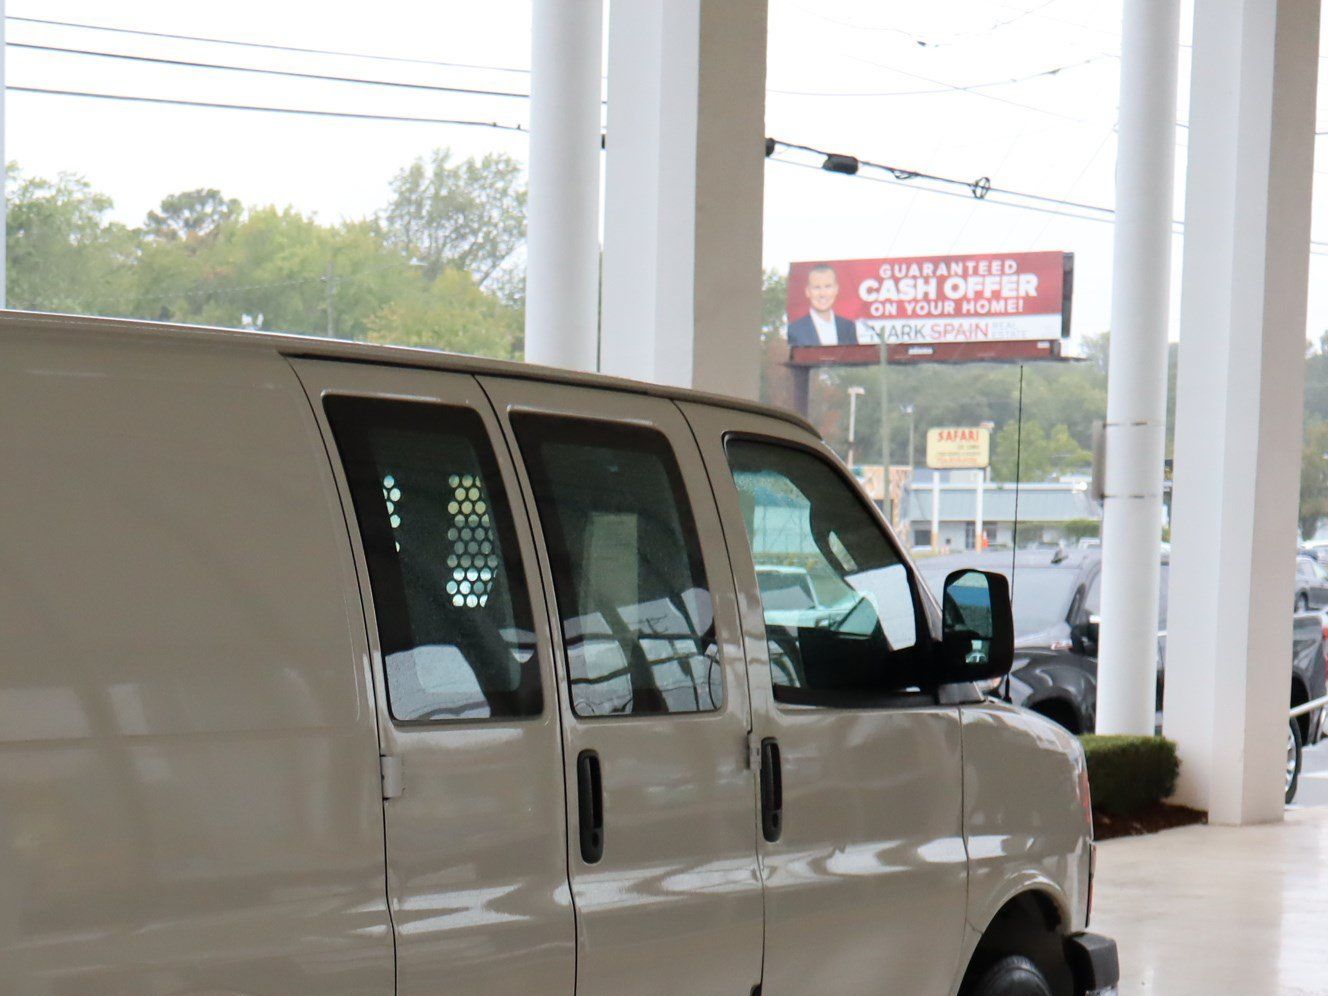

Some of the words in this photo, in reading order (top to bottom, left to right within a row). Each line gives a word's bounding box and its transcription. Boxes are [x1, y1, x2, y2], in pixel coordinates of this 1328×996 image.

[878, 259, 1018, 279] GUARANTEED
[858, 277, 938, 302] CASH
[943, 273, 1039, 300] OFFER
[870, 302, 898, 317] ON
[904, 300, 956, 316] YOUR
[961, 298, 1024, 314] HOME!
[930, 322, 989, 340] SPAIN
[937, 430, 979, 442] SAFARI
